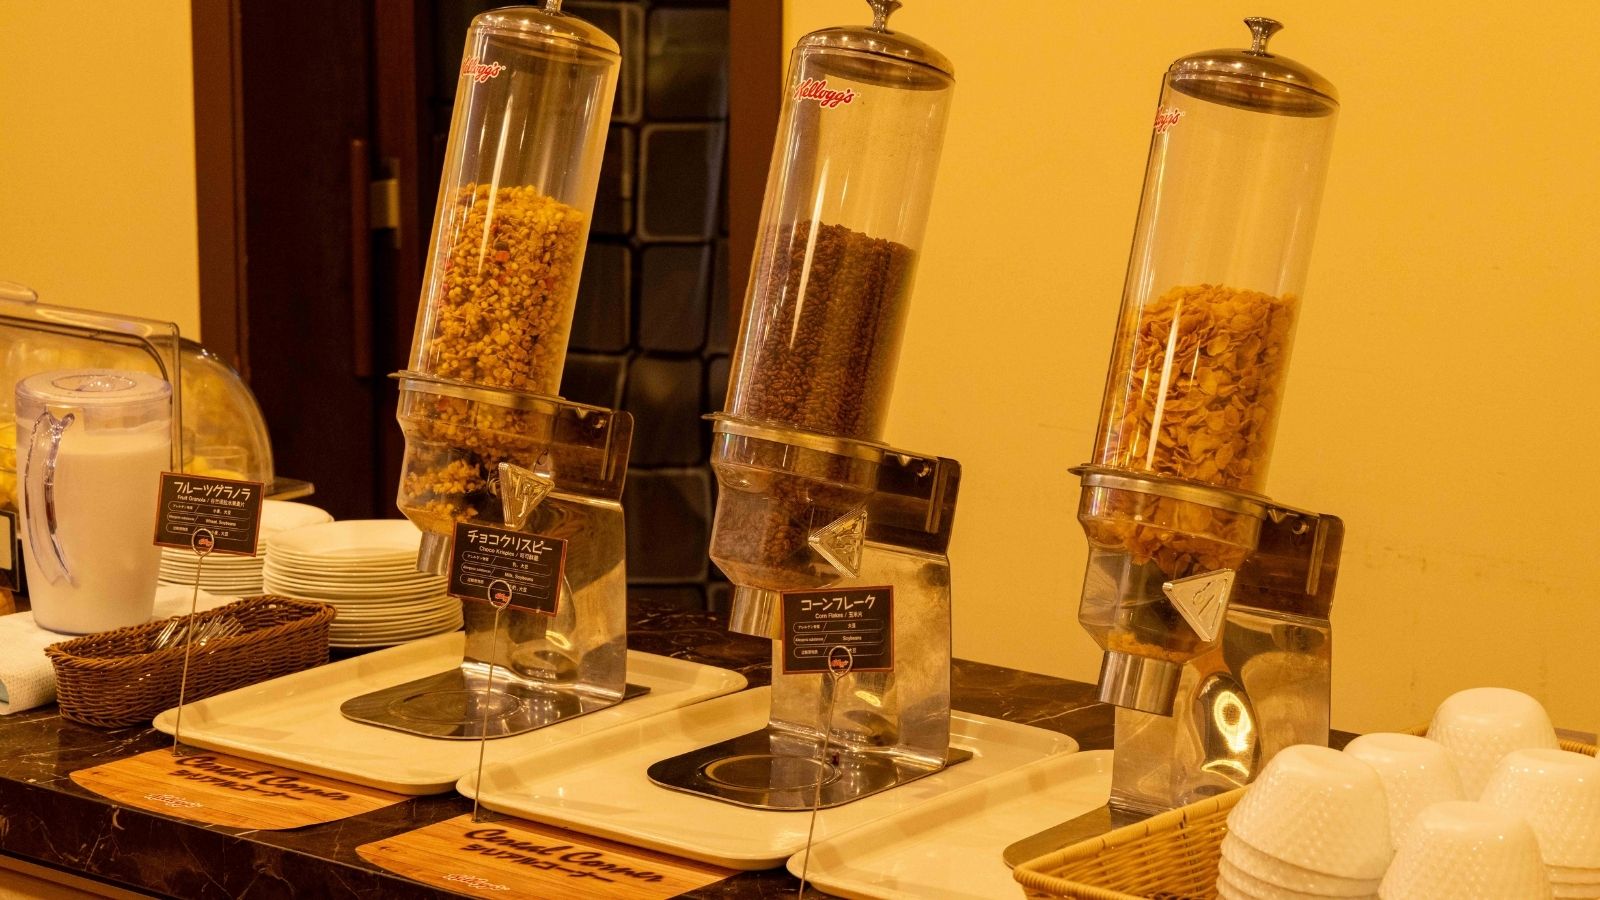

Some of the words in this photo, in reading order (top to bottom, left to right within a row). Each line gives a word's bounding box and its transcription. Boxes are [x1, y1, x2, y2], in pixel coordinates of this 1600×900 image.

[794, 78, 855, 108] Kellogg's
[174, 481, 251, 501] フルーツグラノラ
[188, 495, 206, 503] Granola
[467, 529, 552, 555] チョコクリスピー
[479, 546, 496, 554] Choco
[801, 594, 876, 611] コーンフレーク
[256, 776, 352, 801] Corner
[464, 828, 574, 856] Cereal
[559, 851, 665, 883] Corner
